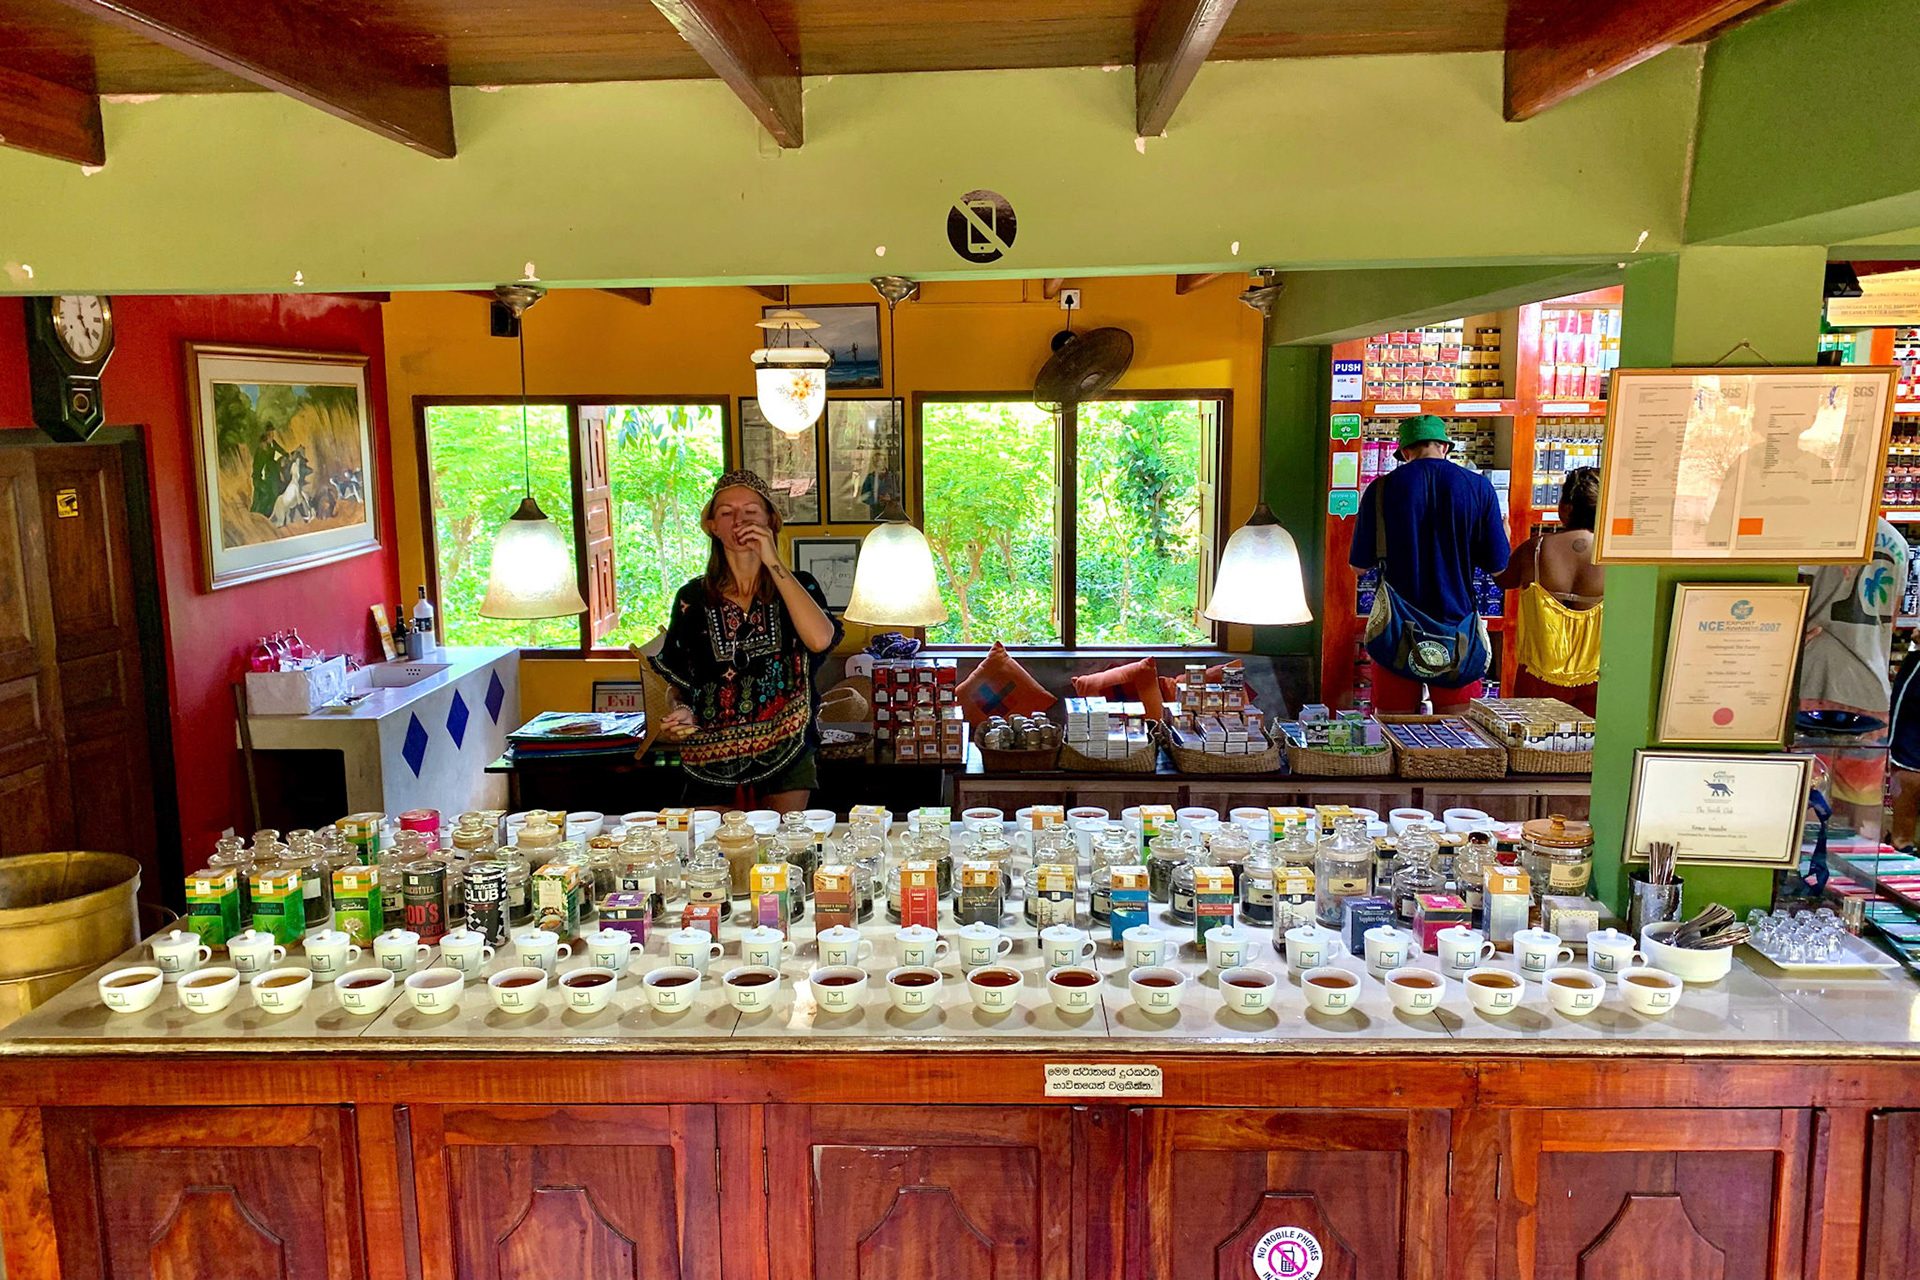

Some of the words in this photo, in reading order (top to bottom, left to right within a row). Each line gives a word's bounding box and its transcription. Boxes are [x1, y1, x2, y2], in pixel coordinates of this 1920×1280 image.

[1334, 363, 1361, 372] PUSH
[1720, 387, 1742, 399] SGS
[1853, 386, 1875, 398] SGS
[1874, 532, 1904, 562] LVER
[1698, 621, 1725, 632] NCE
[1760, 622, 1782, 632] 2007
[607, 695, 635, 707] Evil
[422, 885, 435, 893] TEA
[464, 888, 500, 902] CLUB
[407, 900, 439, 925] OD'S
[1257, 1246, 1268, 1259] NO
[1263, 1230, 1295, 1247] MOBILE
[1296, 1232, 1320, 1262] PHONES
